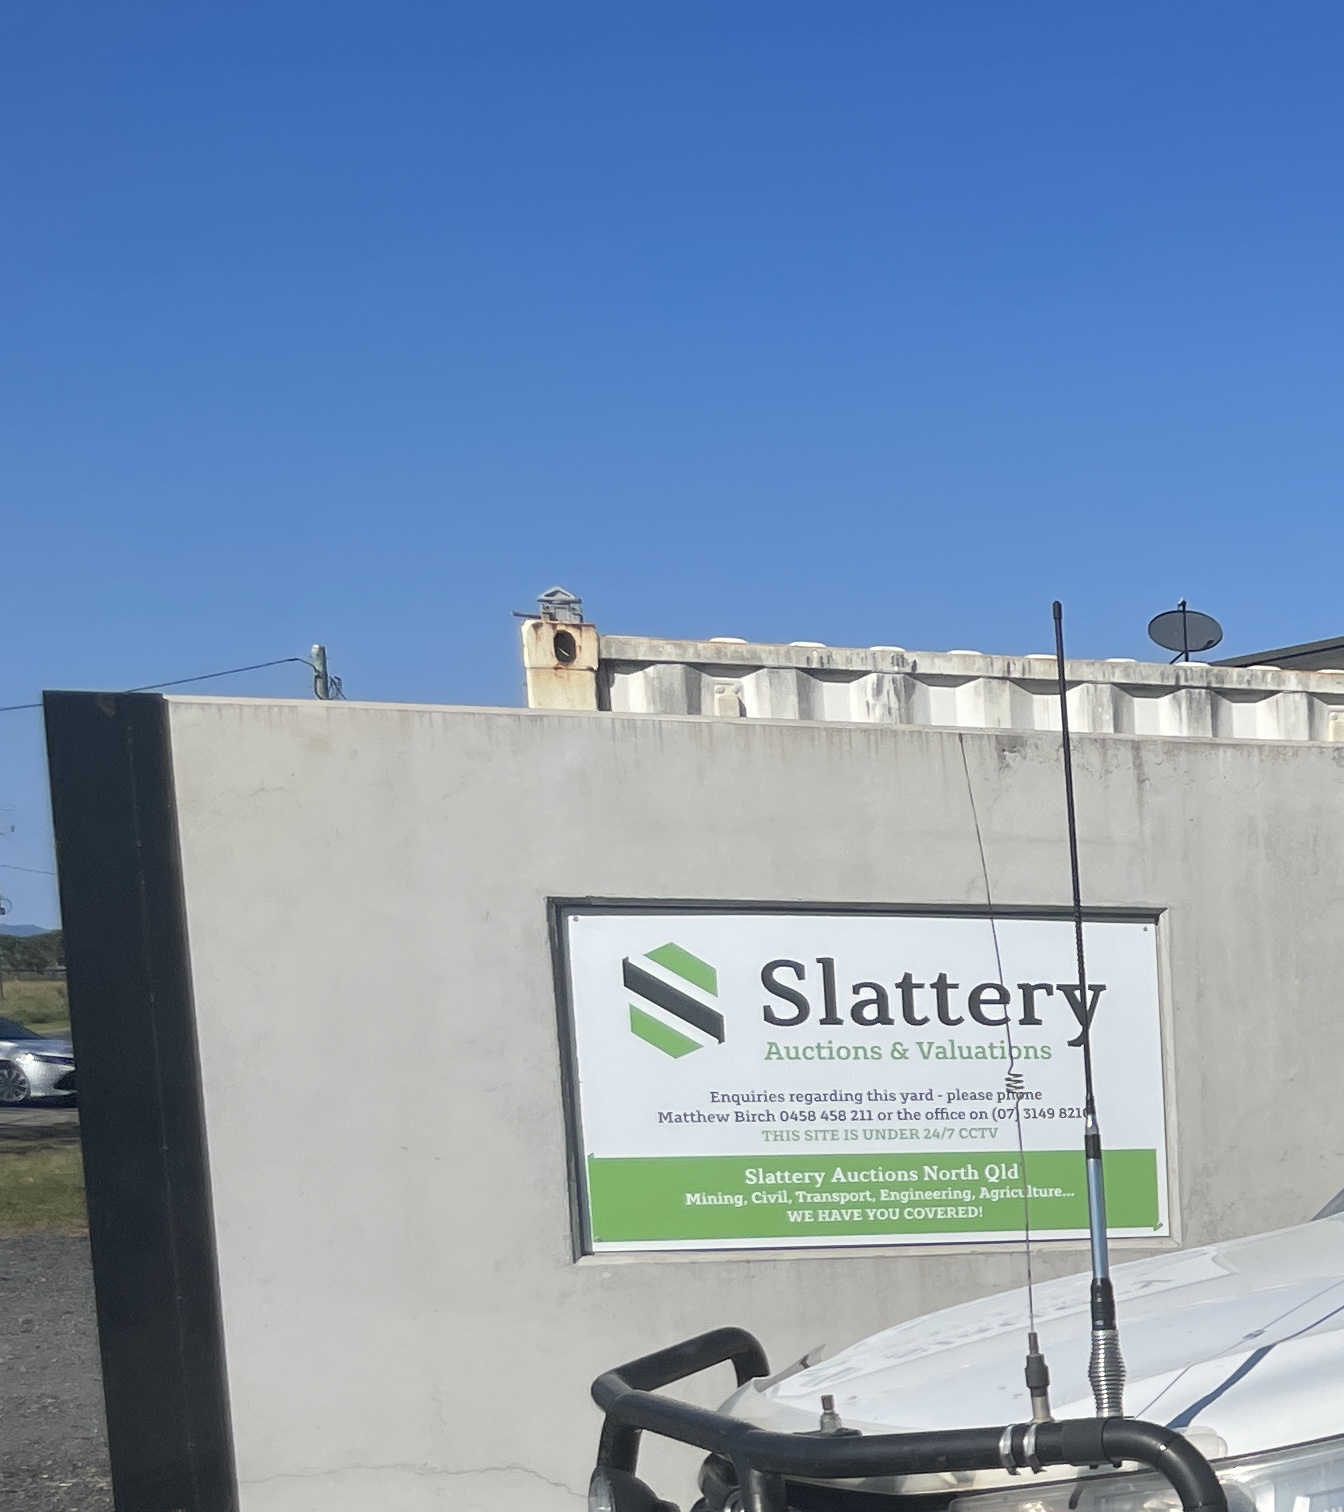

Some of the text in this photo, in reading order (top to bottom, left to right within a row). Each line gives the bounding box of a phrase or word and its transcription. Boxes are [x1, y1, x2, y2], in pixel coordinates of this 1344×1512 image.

[760, 957, 1107, 1047] Slattery
[764, 1039, 1052, 1061] Auctions & Valuations
[710, 1090, 785, 1106] Enquiries
[789, 1088, 863, 1105] regarding
[867, 1088, 896, 1101] this
[900, 1088, 934, 1104] yard
[946, 1089, 993, 1104] please
[996, 1088, 1043, 1103] phone
[658, 1110, 730, 1124] Matthew
[734, 1109, 776, 1123] Birch
[780, 1110, 816, 1122] 0458
[820, 1110, 847, 1122] 458
[851, 1109, 874, 1121] 211
[877, 1110, 894, 1121] or
[897, 1108, 921, 1121] the
[925, 1108, 966, 1121] office
[969, 1110, 989, 1121] on
[1022, 1108, 1055, 1120] 3149
[762, 1127, 999, 1142] THIS SITE IS UNDER 24/7 CCTV
[745, 1163, 1019, 1188] Slattery Auctions North Qld
[685, 1185, 1075, 1207] Mining, Civil, Transport, Engineering, Agriculture...
[787, 1206, 983, 1222] WE HAVE YOU COVERED!
